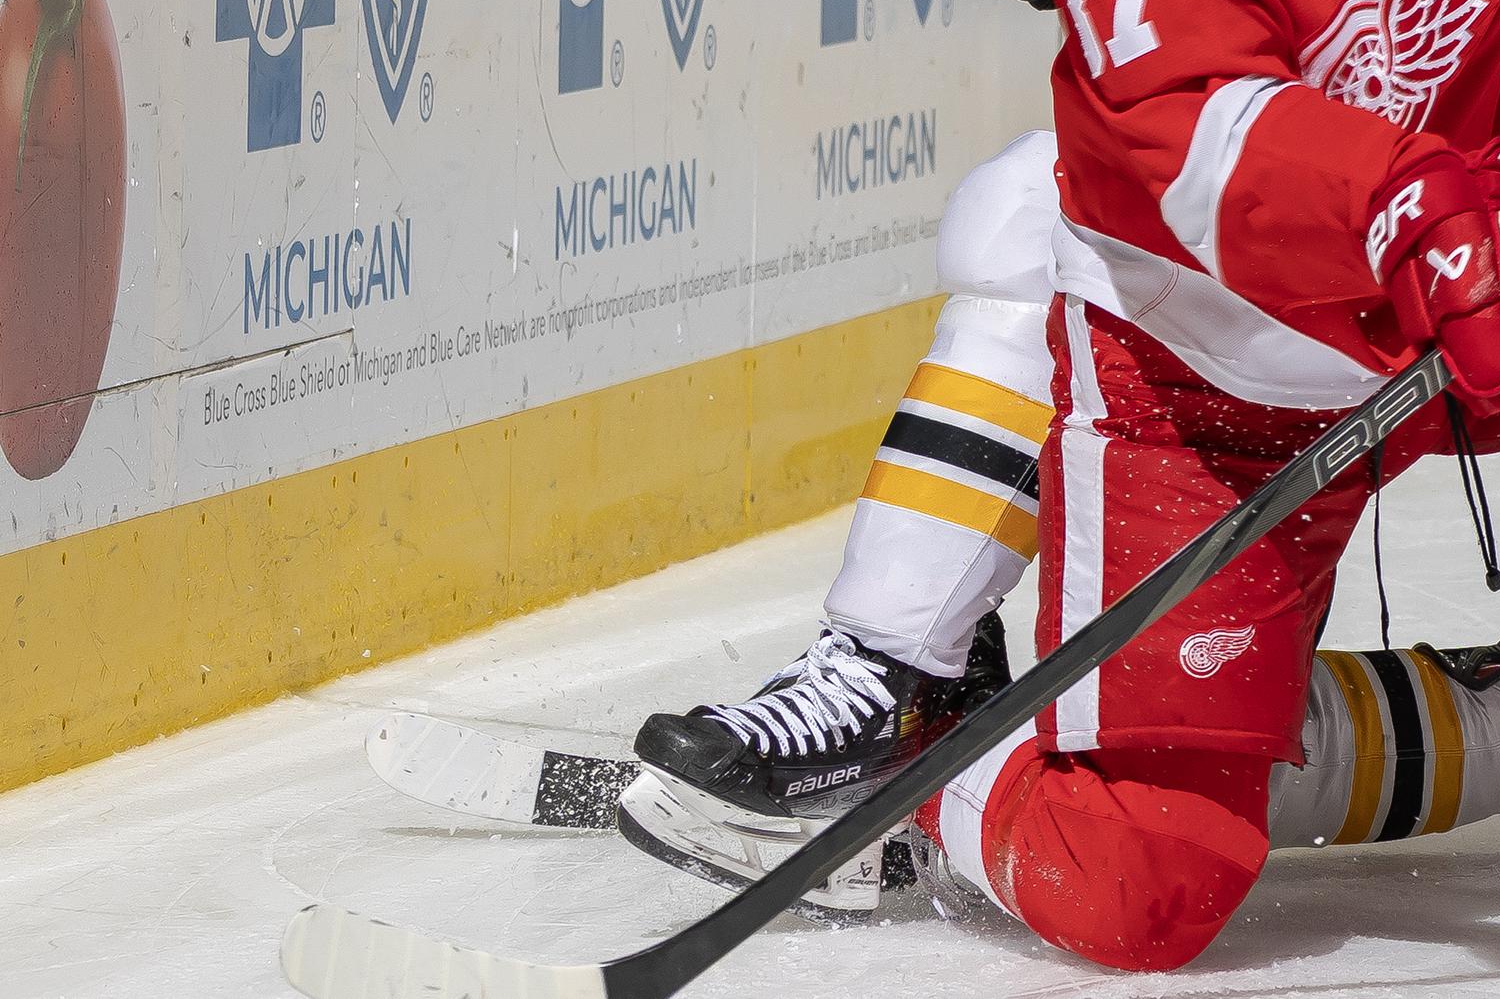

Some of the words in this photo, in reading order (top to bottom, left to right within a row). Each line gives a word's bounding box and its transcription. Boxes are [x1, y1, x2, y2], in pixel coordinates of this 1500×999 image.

[816, 107, 937, 200] MICHIGAN
[554, 158, 698, 261] MICHIGAN
[244, 217, 412, 334] MICHIGAN
[204, 388, 230, 425] Blue
[234, 383, 267, 416] Cross
[270, 371, 296, 407] Blue
[300, 355, 336, 398] Shield
[353, 350, 403, 386] Michigan
[406, 334, 427, 371] and
[430, 329, 453, 365] Blue
[456, 325, 481, 358] Care
[485, 310, 528, 351] Network
[530, 314, 546, 339] are
[549, 300, 594, 339] nonprofit
[596, 286, 657, 329] corporations
[659, 272, 678, 307] and
[785, 765, 862, 797] BAUER
